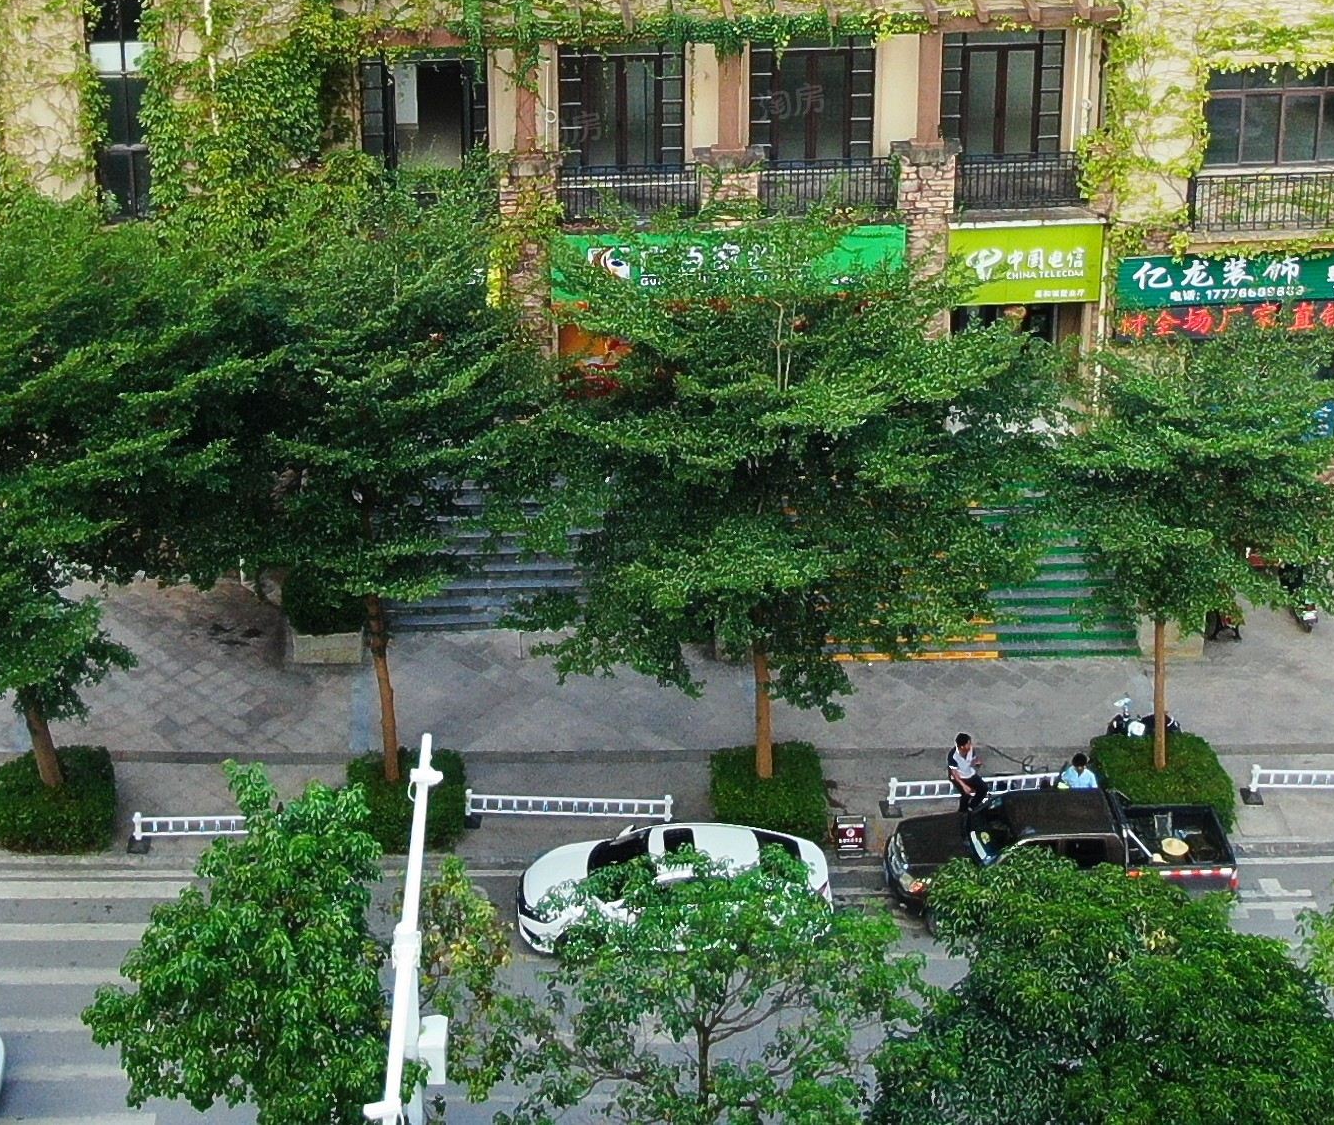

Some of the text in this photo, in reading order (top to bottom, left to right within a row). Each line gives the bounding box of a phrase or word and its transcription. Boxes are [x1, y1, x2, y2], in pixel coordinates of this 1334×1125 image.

[1007, 247, 1085, 271] 中国电信
[1006, 269, 1084, 280] CHINA TELECOM
[1132, 256, 1300, 290] 亿龙装饰
